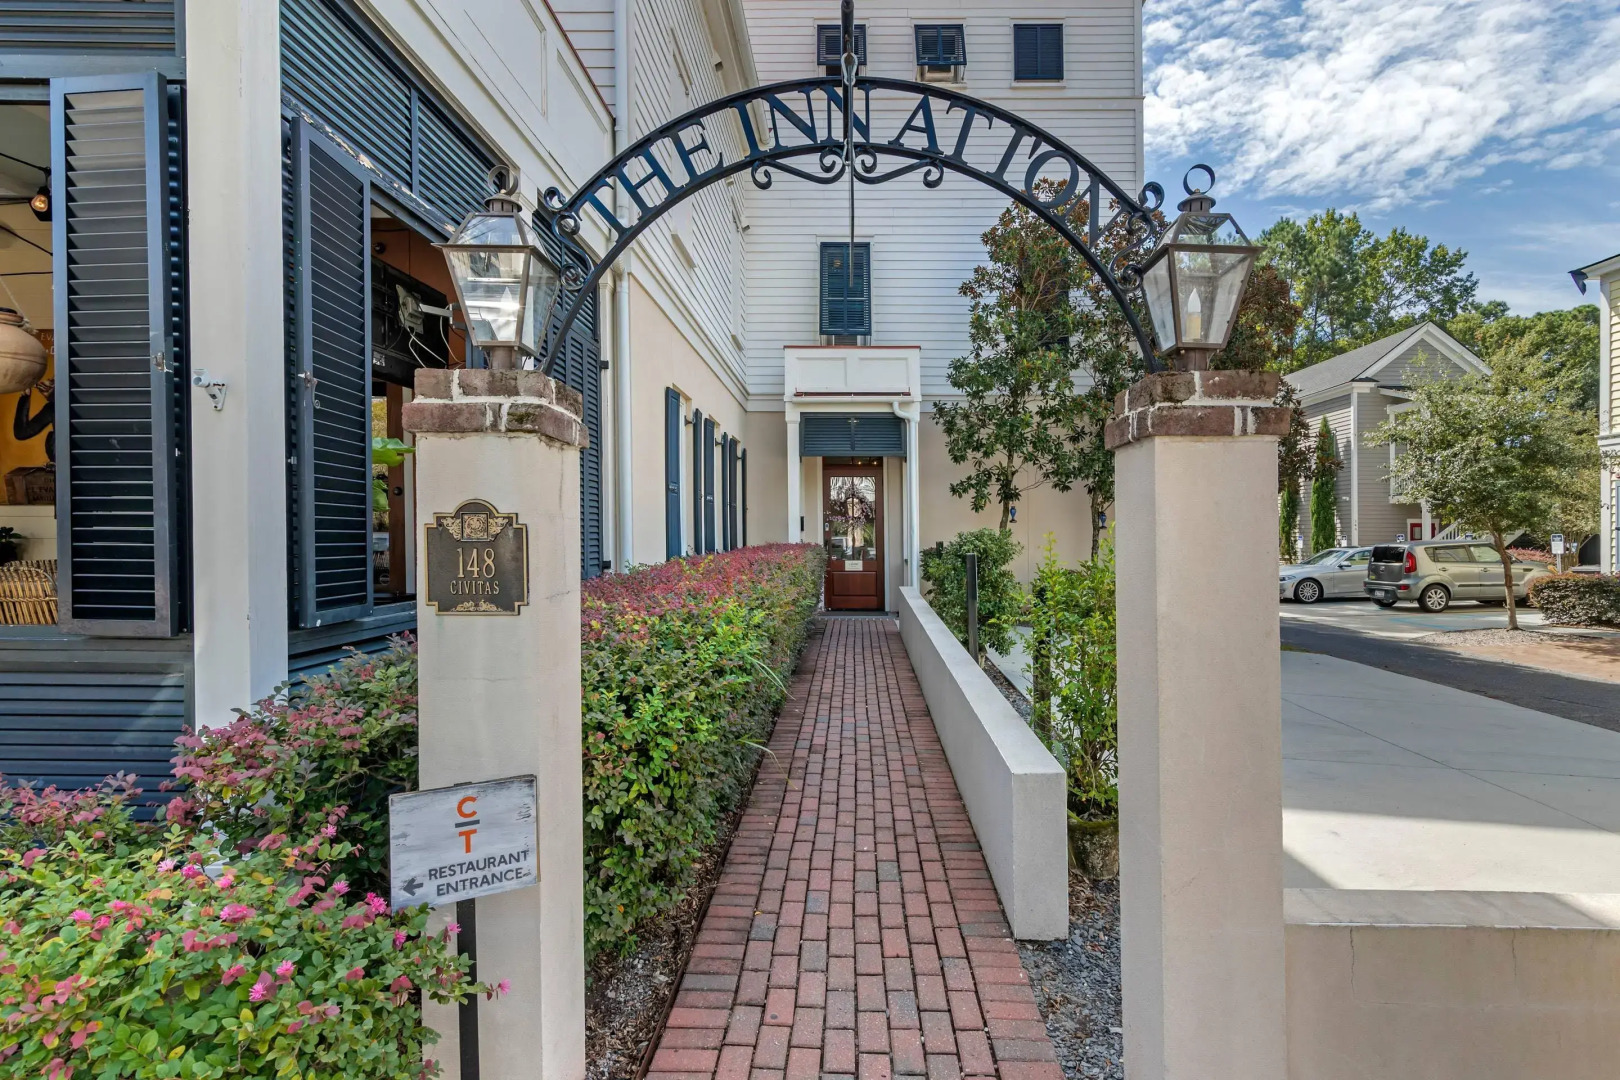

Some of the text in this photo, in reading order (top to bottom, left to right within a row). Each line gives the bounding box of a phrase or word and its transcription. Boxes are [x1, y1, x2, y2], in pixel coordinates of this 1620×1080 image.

[571, 118, 723, 243] THE
[729, 84, 876, 158] INN
[888, 94, 994, 166] AT
[457, 548, 495, 578] 148
[450, 580, 500, 595] CIVITAS
[457, 795, 478, 819] C
[458, 829, 478, 854] T
[428, 849, 530, 881] RESTAURANT
[436, 867, 524, 897] ENTRANCE
